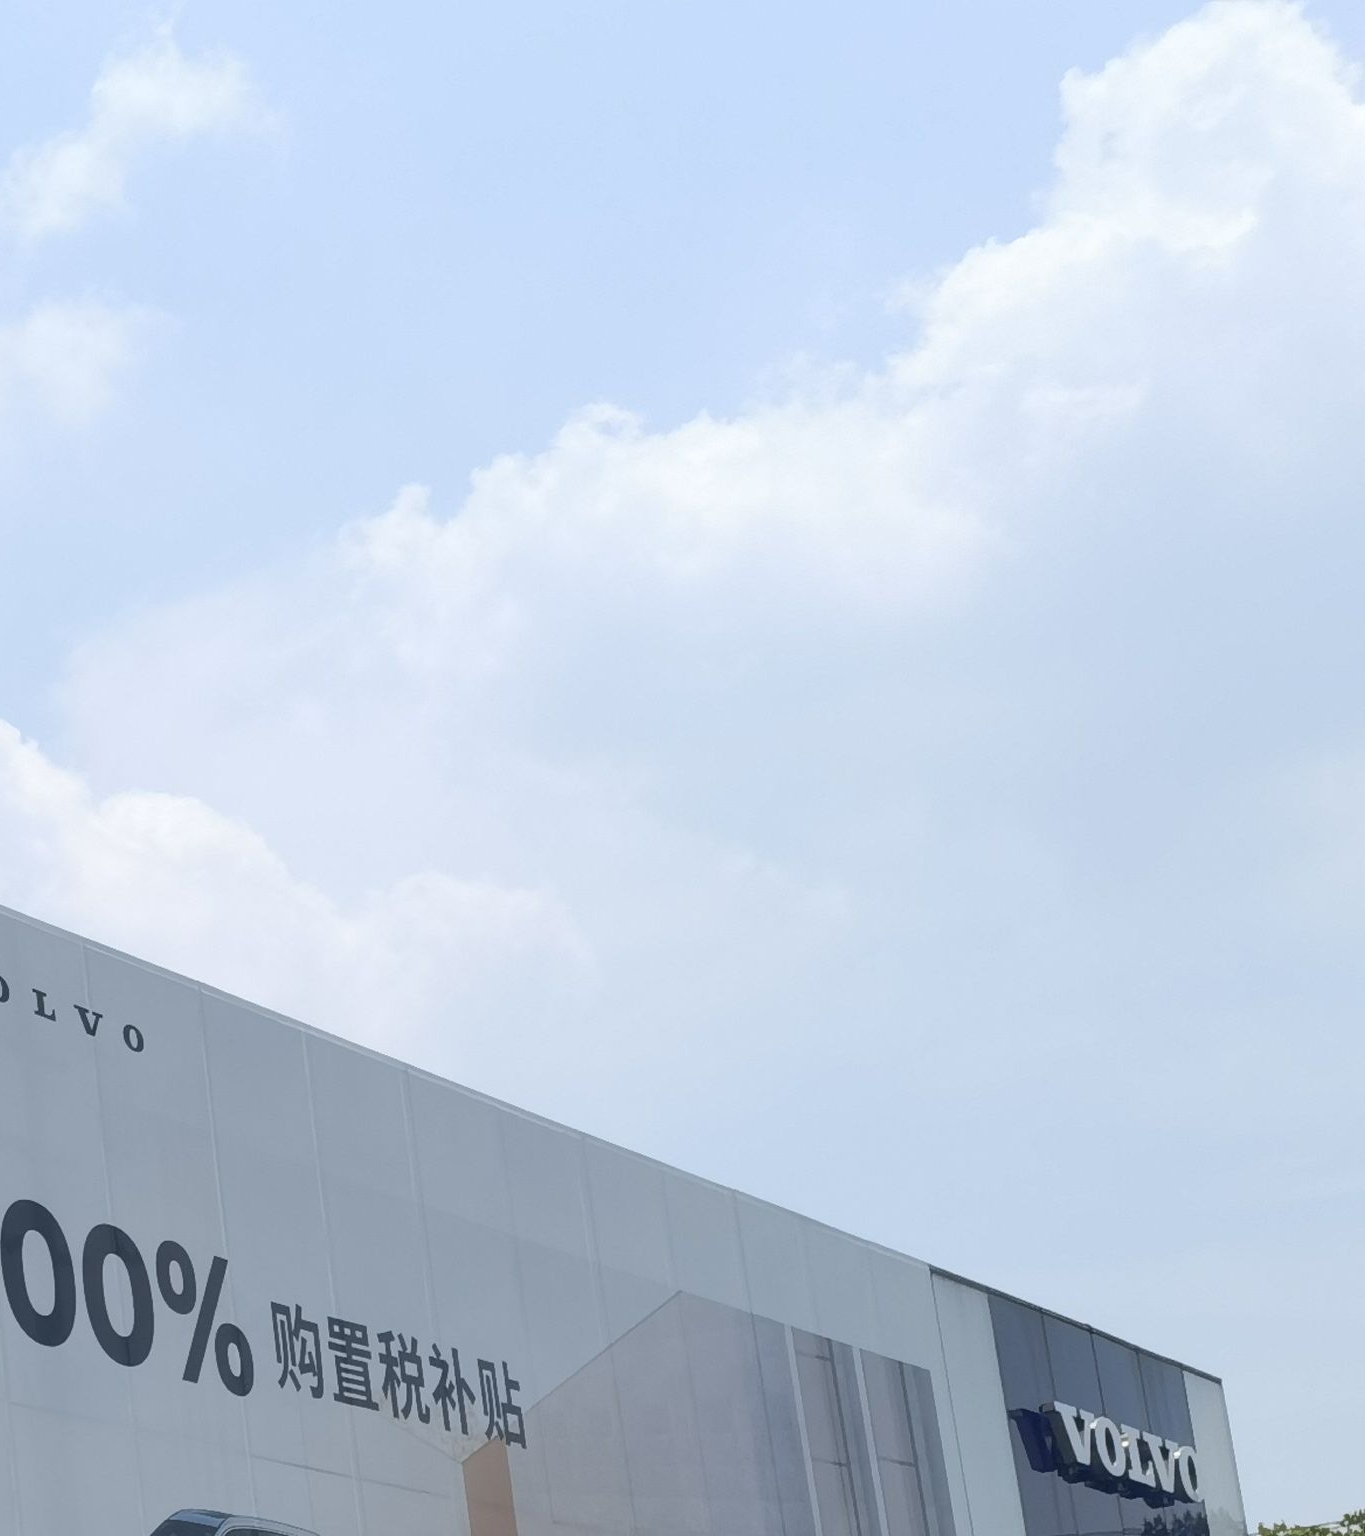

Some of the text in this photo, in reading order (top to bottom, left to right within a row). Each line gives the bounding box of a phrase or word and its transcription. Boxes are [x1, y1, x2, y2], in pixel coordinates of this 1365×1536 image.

[270, 1300, 528, 1450] 购置税补贴
[1051, 1400, 1205, 1503] VOLVO
